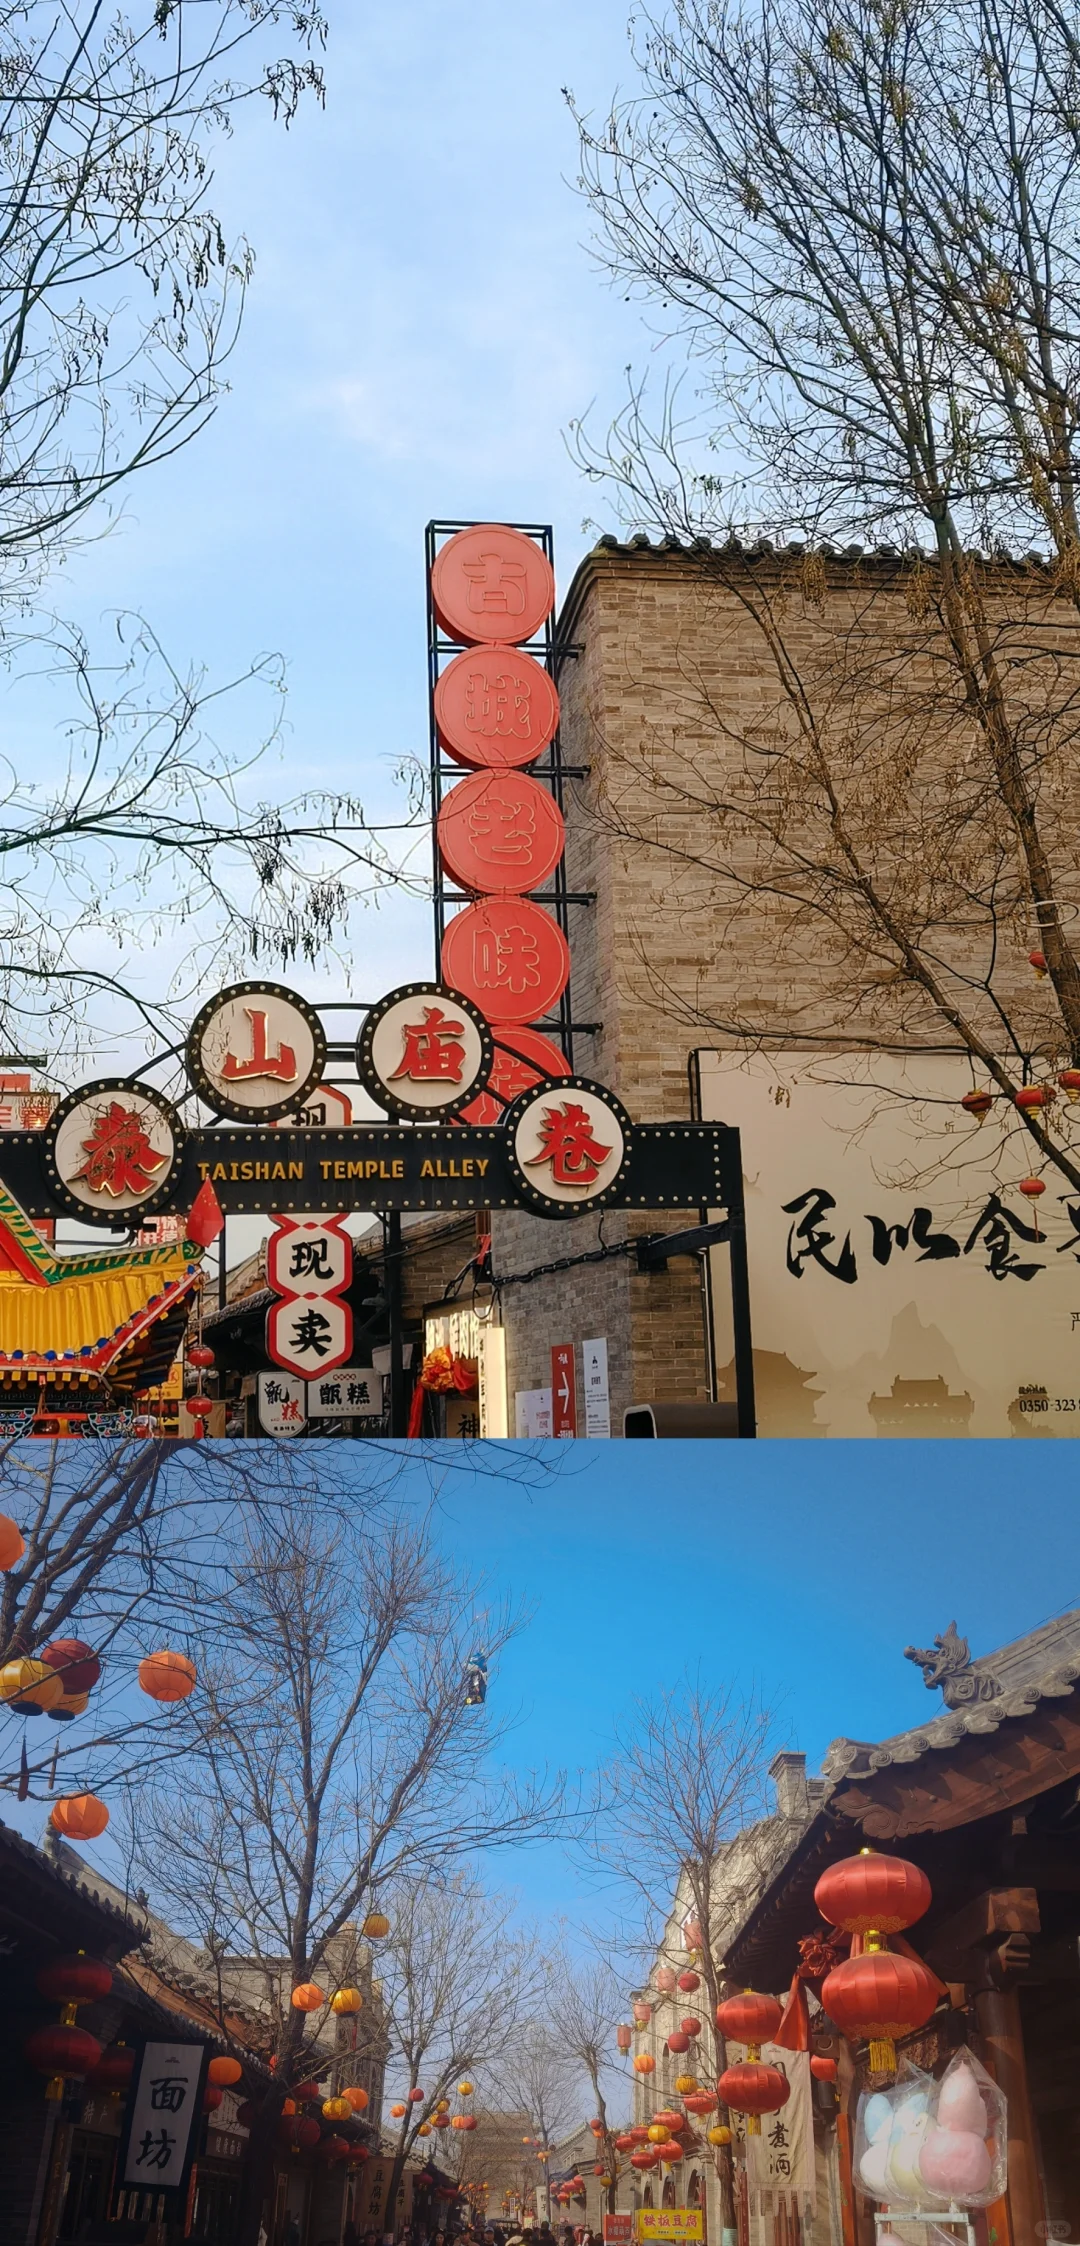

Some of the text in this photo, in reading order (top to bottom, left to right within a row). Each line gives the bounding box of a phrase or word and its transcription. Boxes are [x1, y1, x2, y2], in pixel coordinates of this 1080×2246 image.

[197, 1159, 489, 1180] TAISHAN TEMPLE ALLEY
[781, 1187, 1080, 1284] 民以食
[289, 1237, 334, 1357] 现卖
[319, 1381, 370, 1405] 甑糕
[1019, 1399, 1080, 1413] 0350-323
[135, 2076, 188, 2170] 面坊
[367, 2169, 385, 2216] 豆腐坊
[643, 2214, 698, 2228] 铁板豆腐
